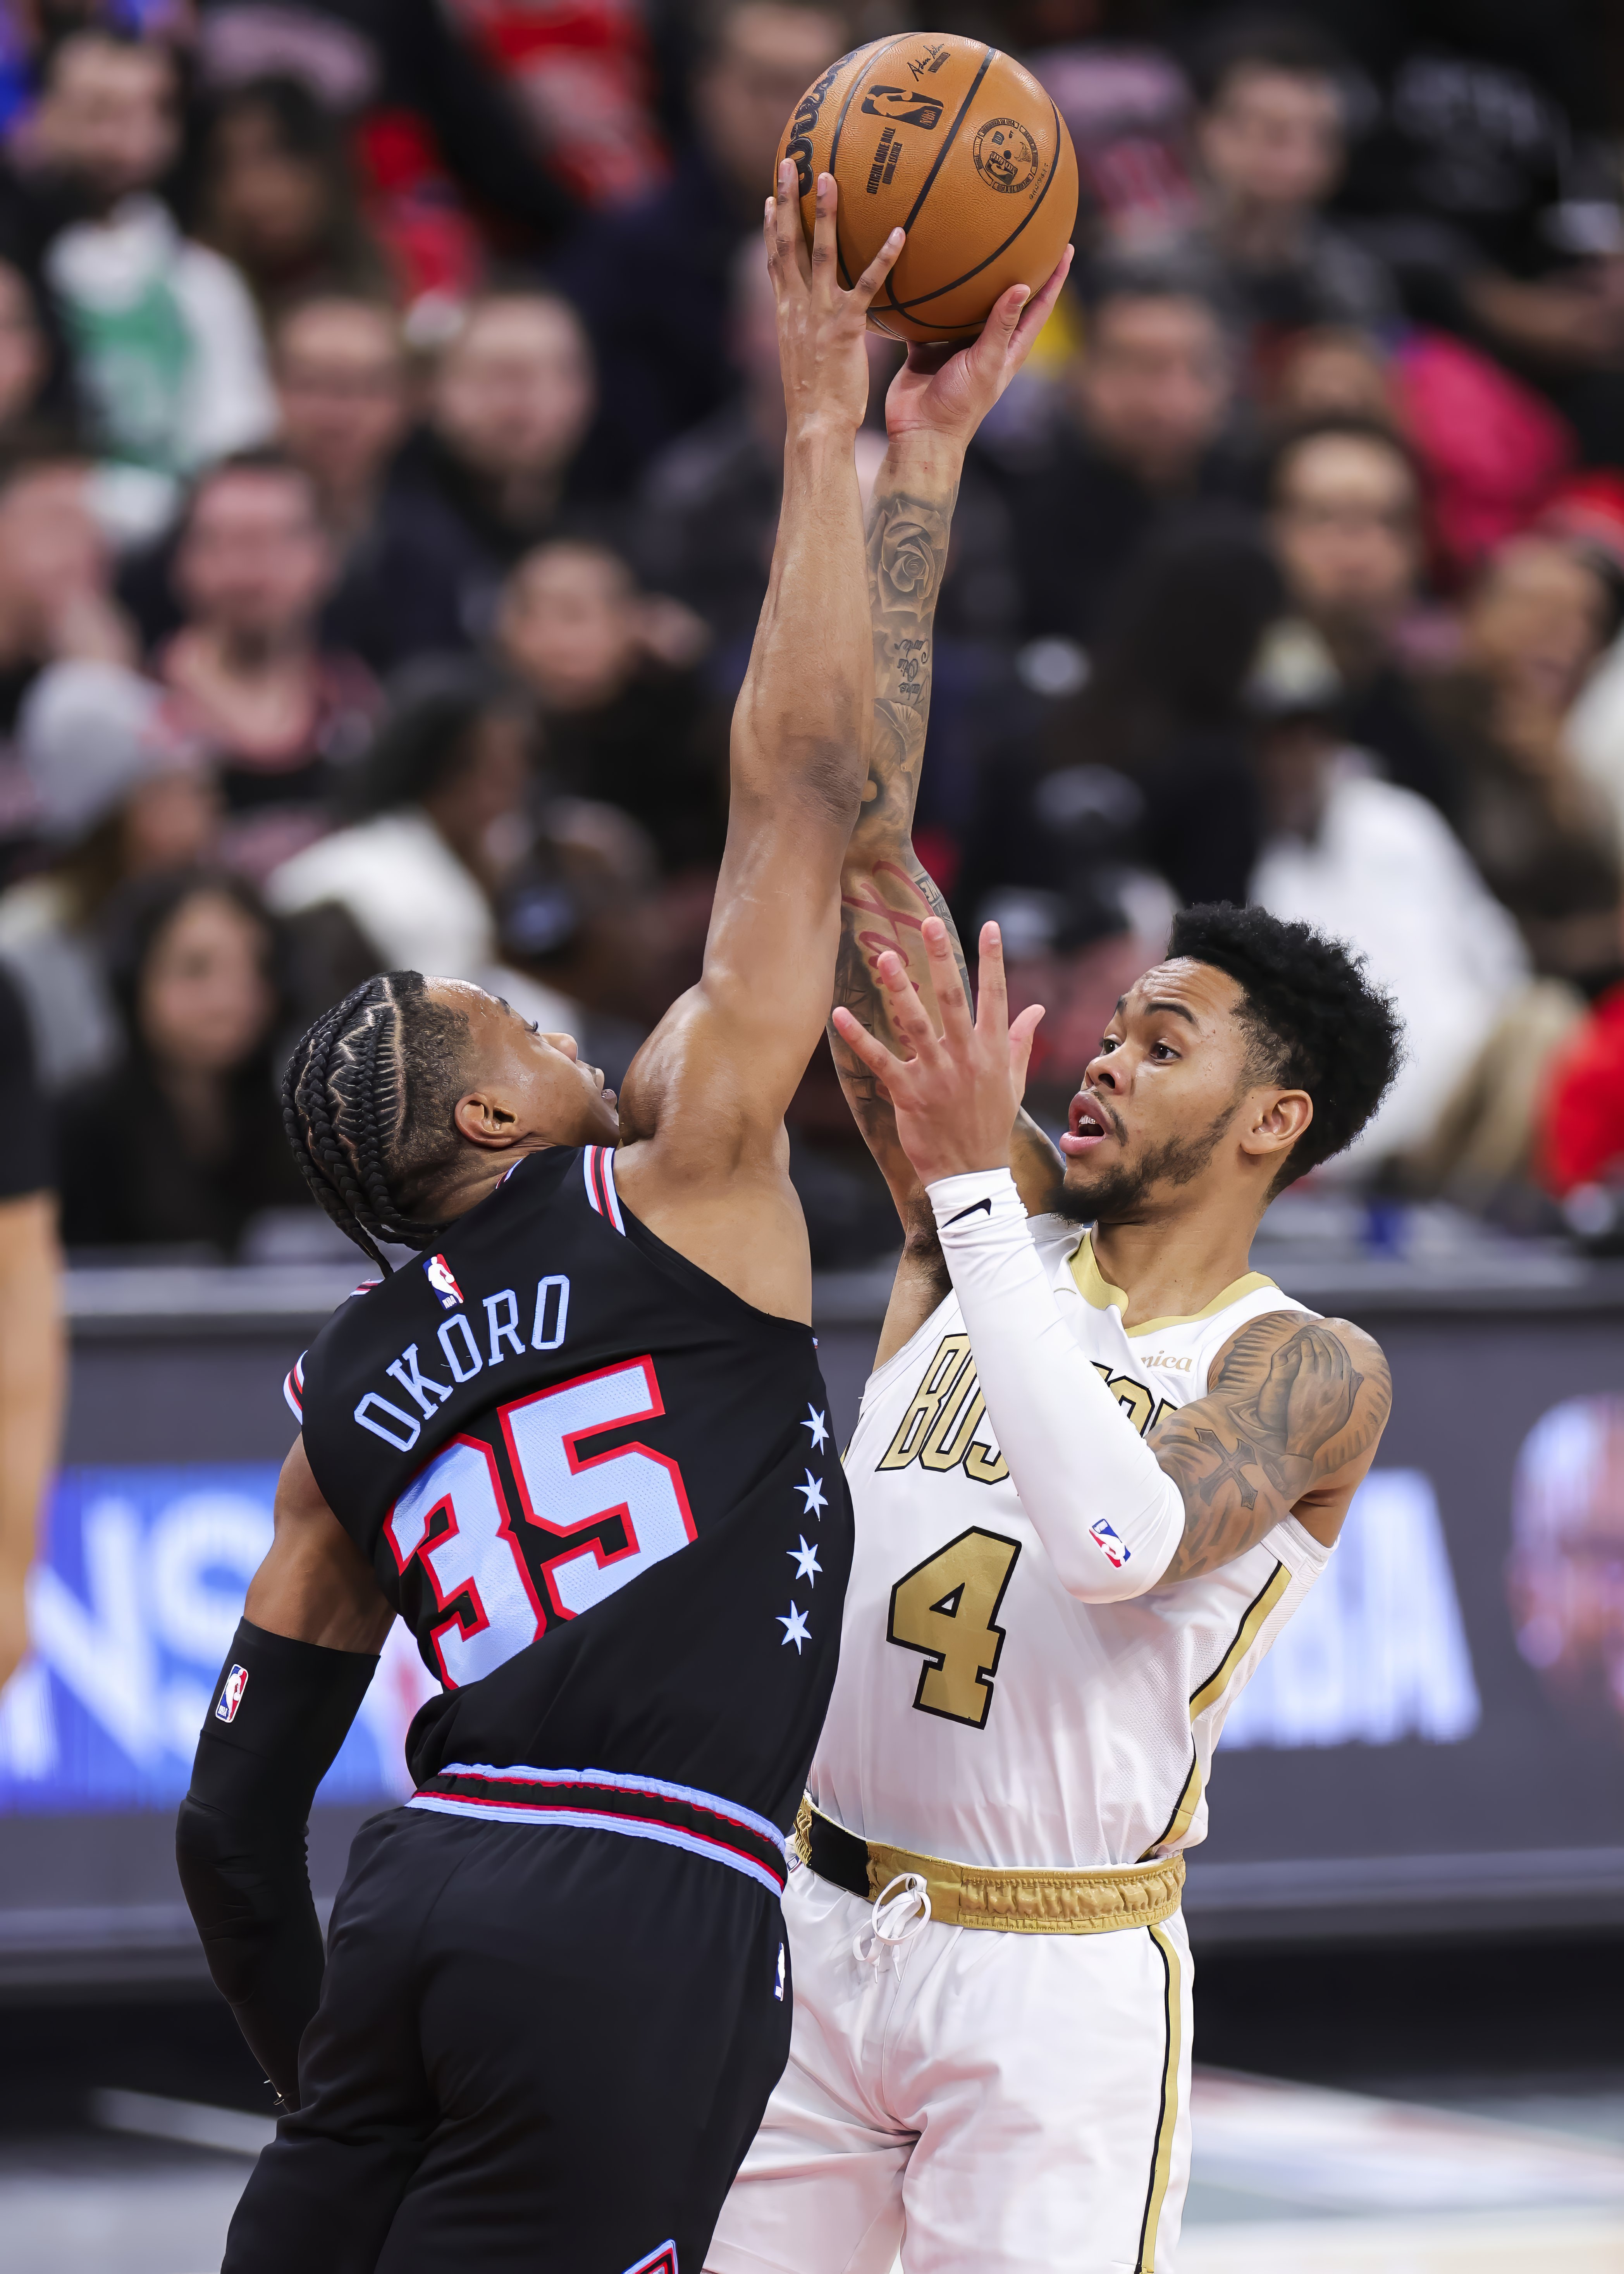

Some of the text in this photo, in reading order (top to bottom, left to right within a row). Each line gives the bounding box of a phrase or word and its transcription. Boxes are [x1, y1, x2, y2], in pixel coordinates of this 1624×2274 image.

[354, 1275, 570, 1452] OKORO
[383, 1353, 698, 1690] 35
[886, 1525, 1022, 1730] 4
